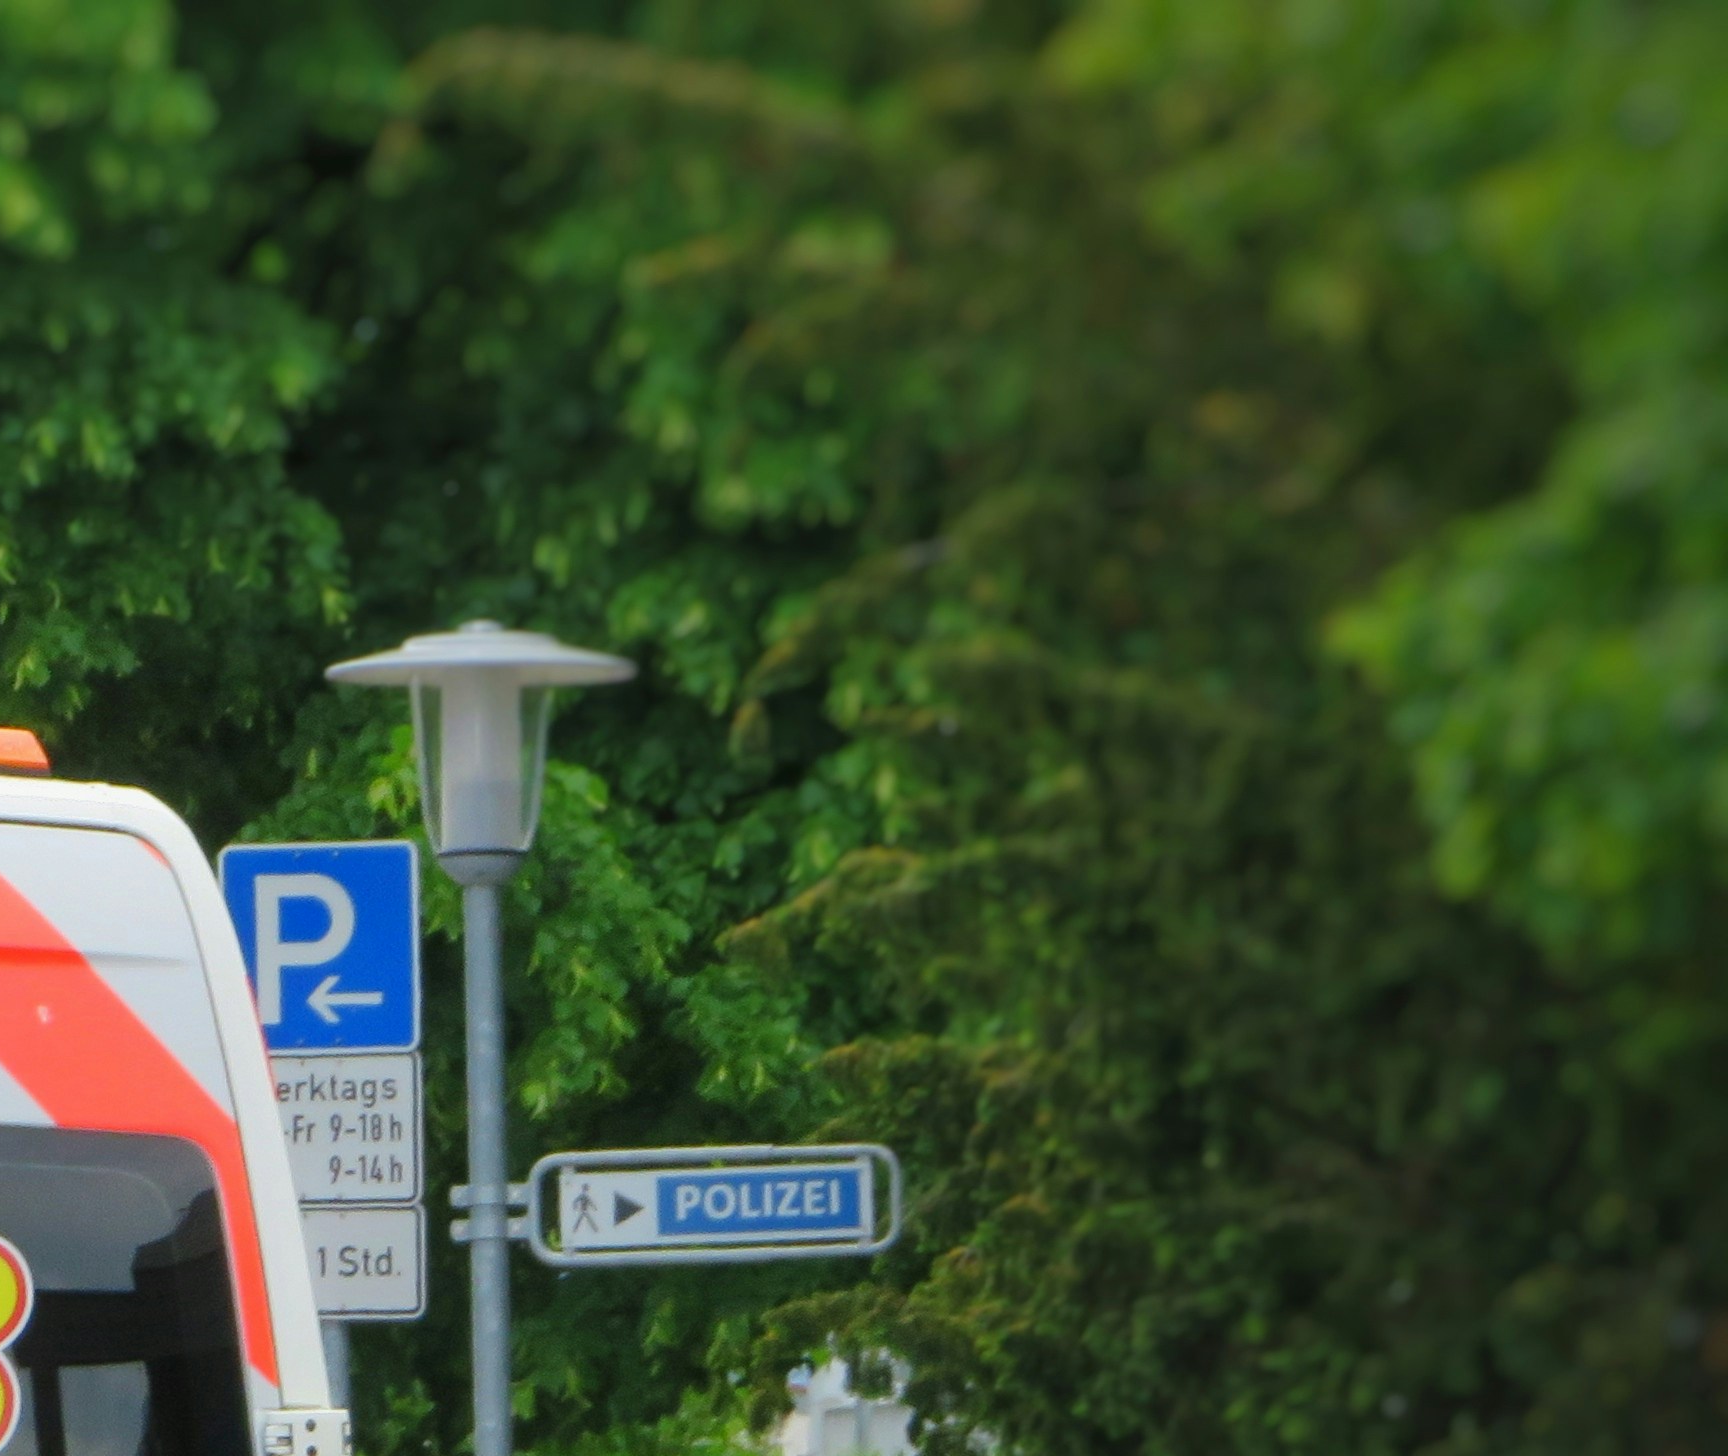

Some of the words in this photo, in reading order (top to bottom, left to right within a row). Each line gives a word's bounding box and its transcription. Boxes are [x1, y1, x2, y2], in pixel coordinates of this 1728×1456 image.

[253, 874, 356, 1026] P
[277, 1074, 397, 1108] erktags
[330, 1113, 383, 1143] 9-18
[390, 1112, 402, 1142] h
[329, 1154, 384, 1185] 9-14
[390, 1155, 403, 1184] h
[675, 1179, 841, 1222] POLIZEI
[317, 1245, 328, 1278] 1
[337, 1244, 402, 1277] Std.
